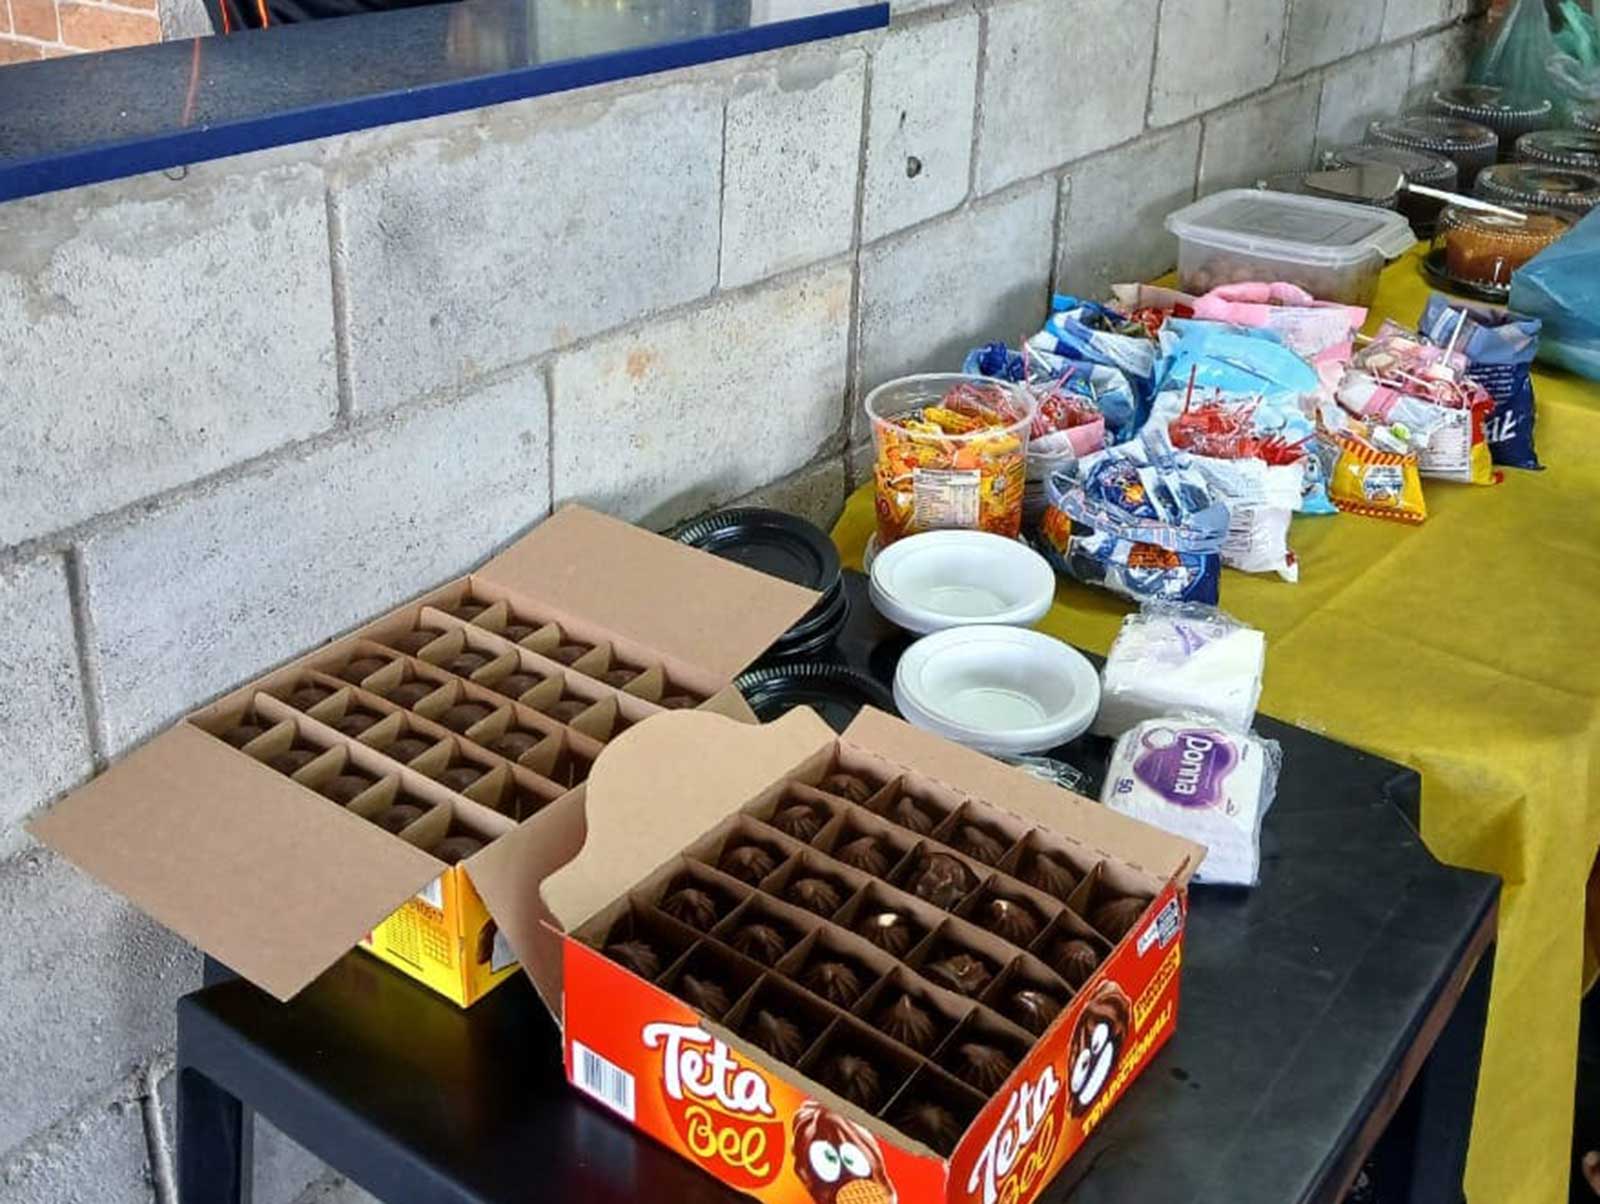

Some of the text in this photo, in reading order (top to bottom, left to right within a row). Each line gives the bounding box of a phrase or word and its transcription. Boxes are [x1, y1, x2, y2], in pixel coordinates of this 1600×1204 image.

[1117, 777, 1134, 794] 50
[1173, 734, 1213, 796] Donna
[642, 1021, 776, 1116] Teta
[967, 1065, 1060, 1204] Teta
